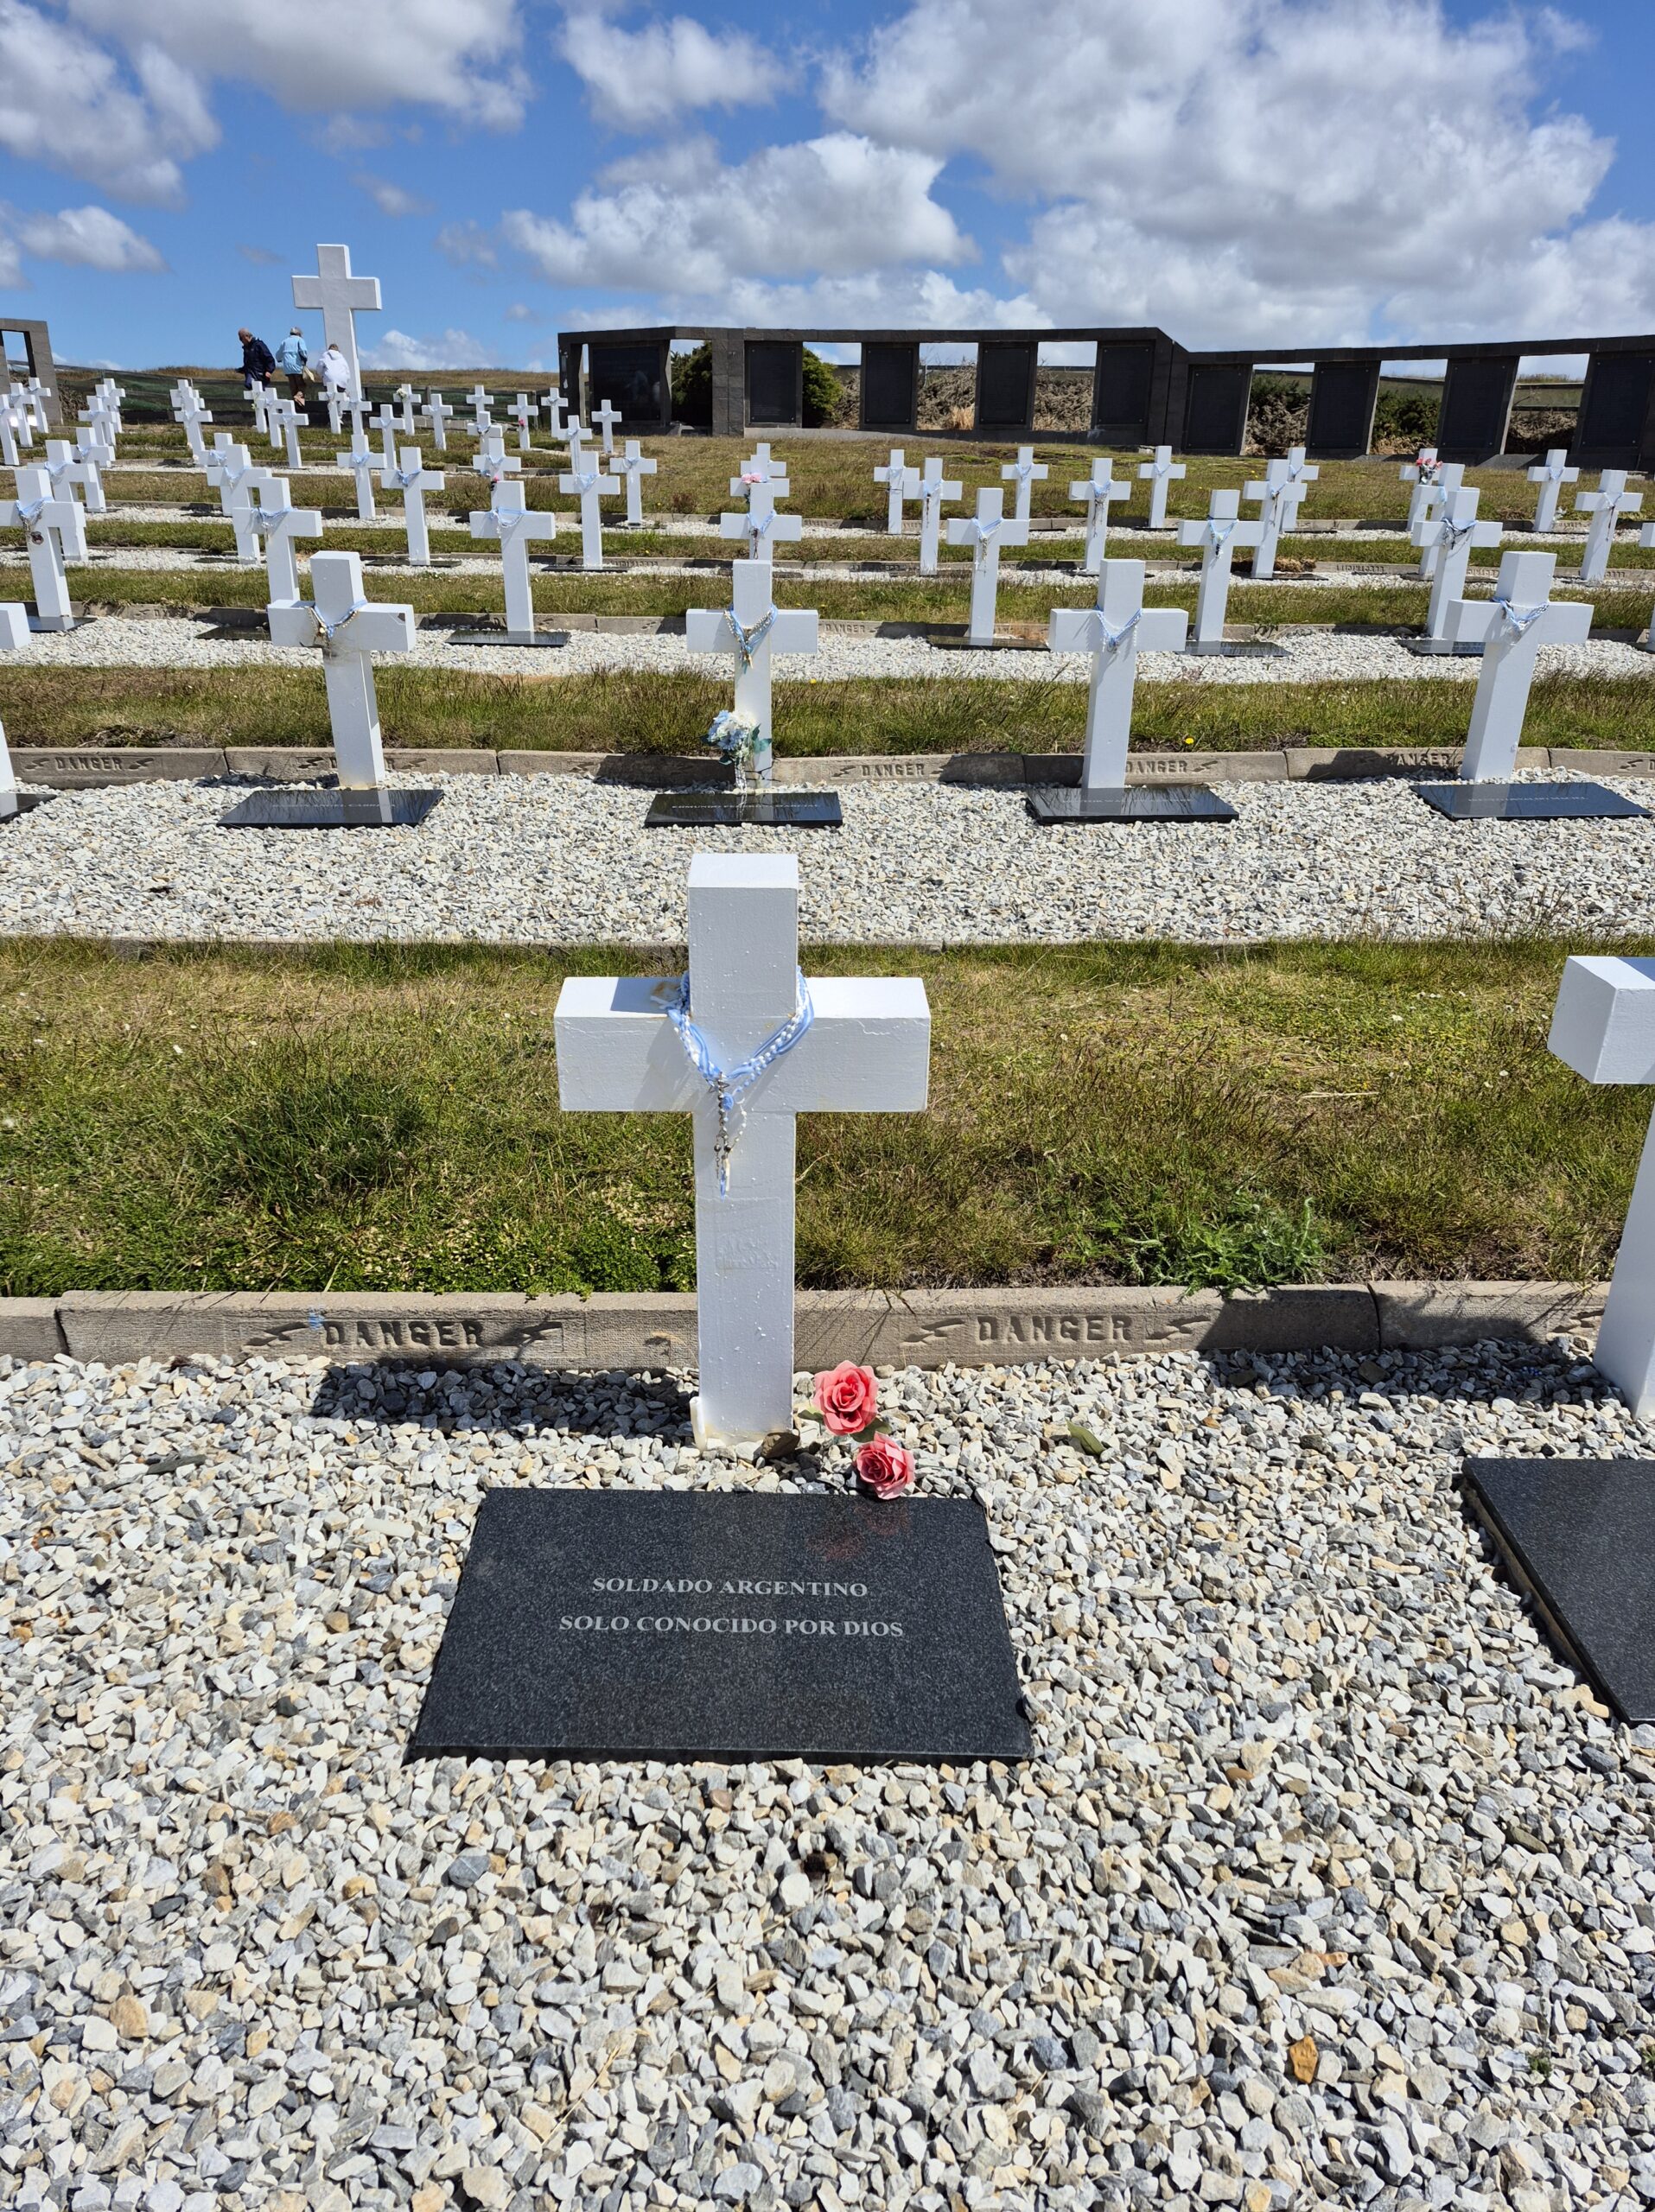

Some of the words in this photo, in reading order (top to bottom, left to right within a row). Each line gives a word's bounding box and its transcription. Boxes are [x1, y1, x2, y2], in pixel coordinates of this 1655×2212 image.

[824, 623, 865, 633] DANGER
[55, 756, 123, 771] DANGER
[862, 763, 926, 777] DANGER
[1126, 760, 1188, 773] DANGER
[323, 1319, 483, 1348] DANGER
[977, 1314, 1134, 1342] DANGER
[592, 1578, 713, 1594] SOLDADO
[719, 1580, 868, 1598] ARGENTINO
[559, 1616, 630, 1631] SOLO
[636, 1617, 777, 1633] CONOCIDO
[783, 1619, 837, 1635] POR
[843, 1620, 904, 1637] DIOS
